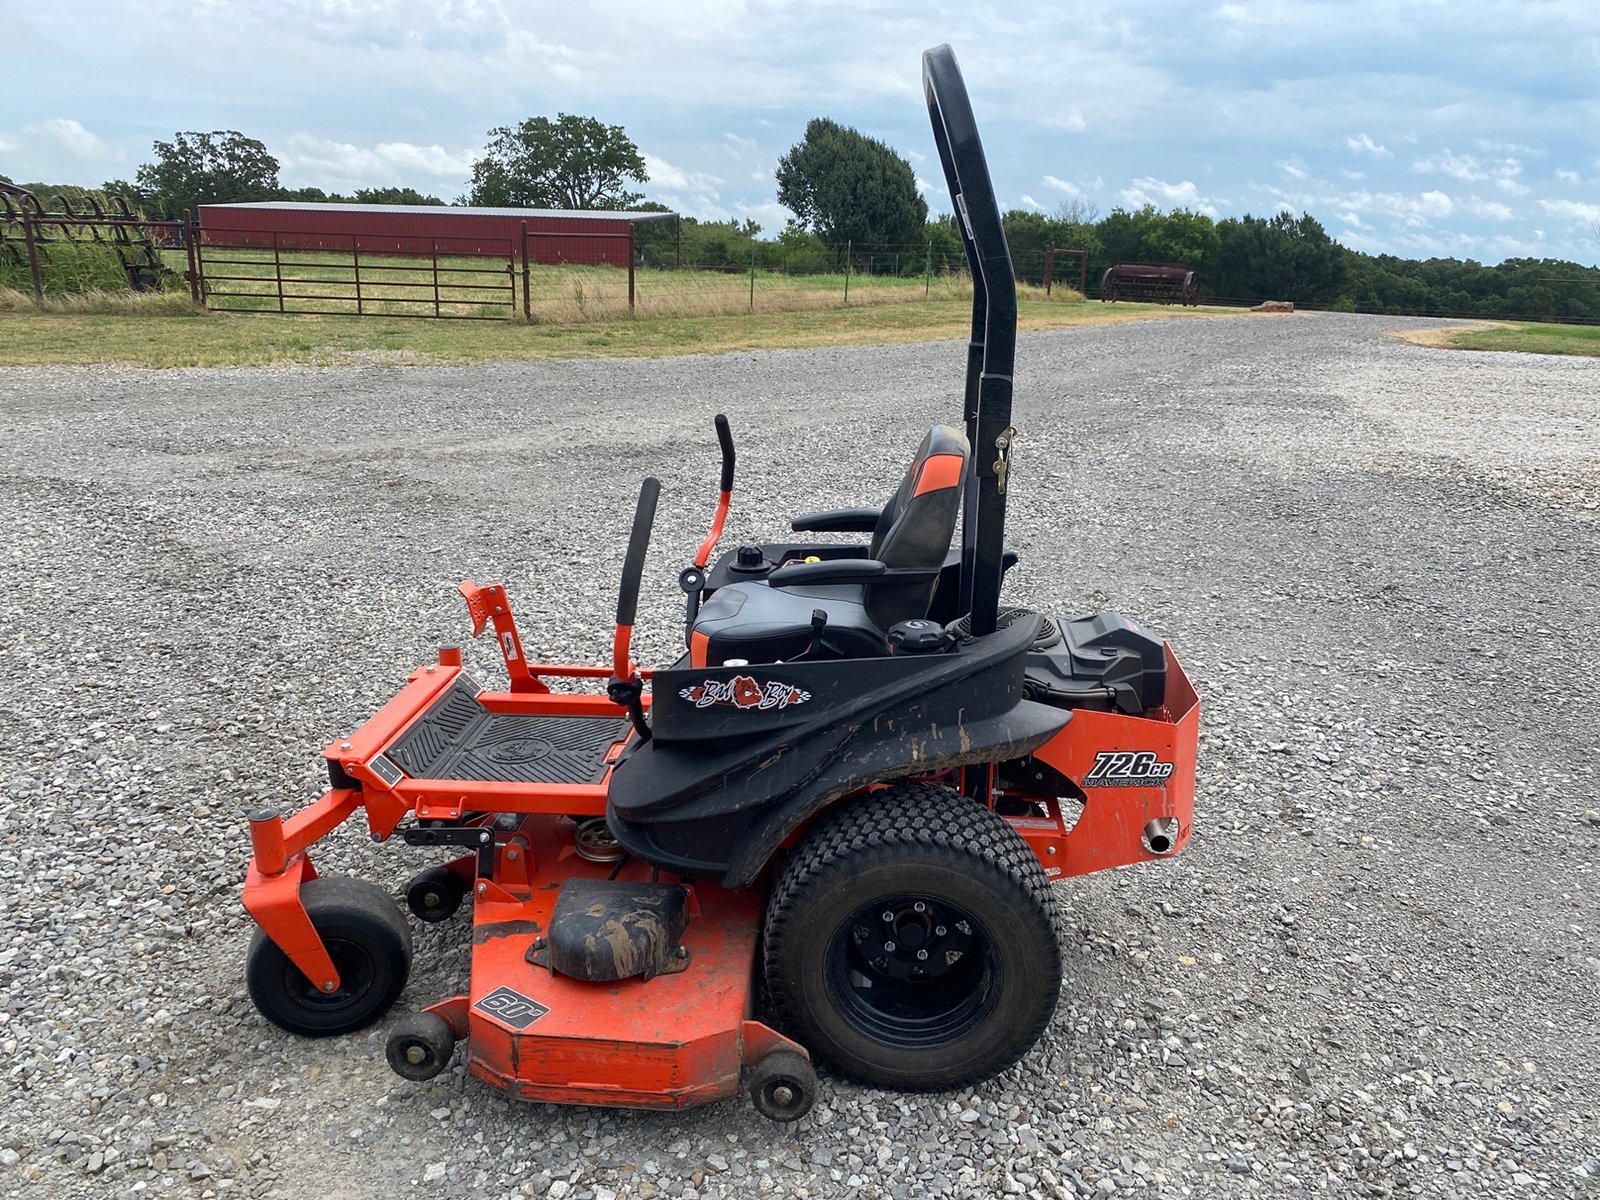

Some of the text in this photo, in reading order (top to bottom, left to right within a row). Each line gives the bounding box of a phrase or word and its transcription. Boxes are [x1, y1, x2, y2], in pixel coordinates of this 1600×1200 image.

[696, 680, 794, 709] Bad Boy
[1088, 751, 1173, 778] 726cc
[1082, 778, 1168, 787] MAVERICK
